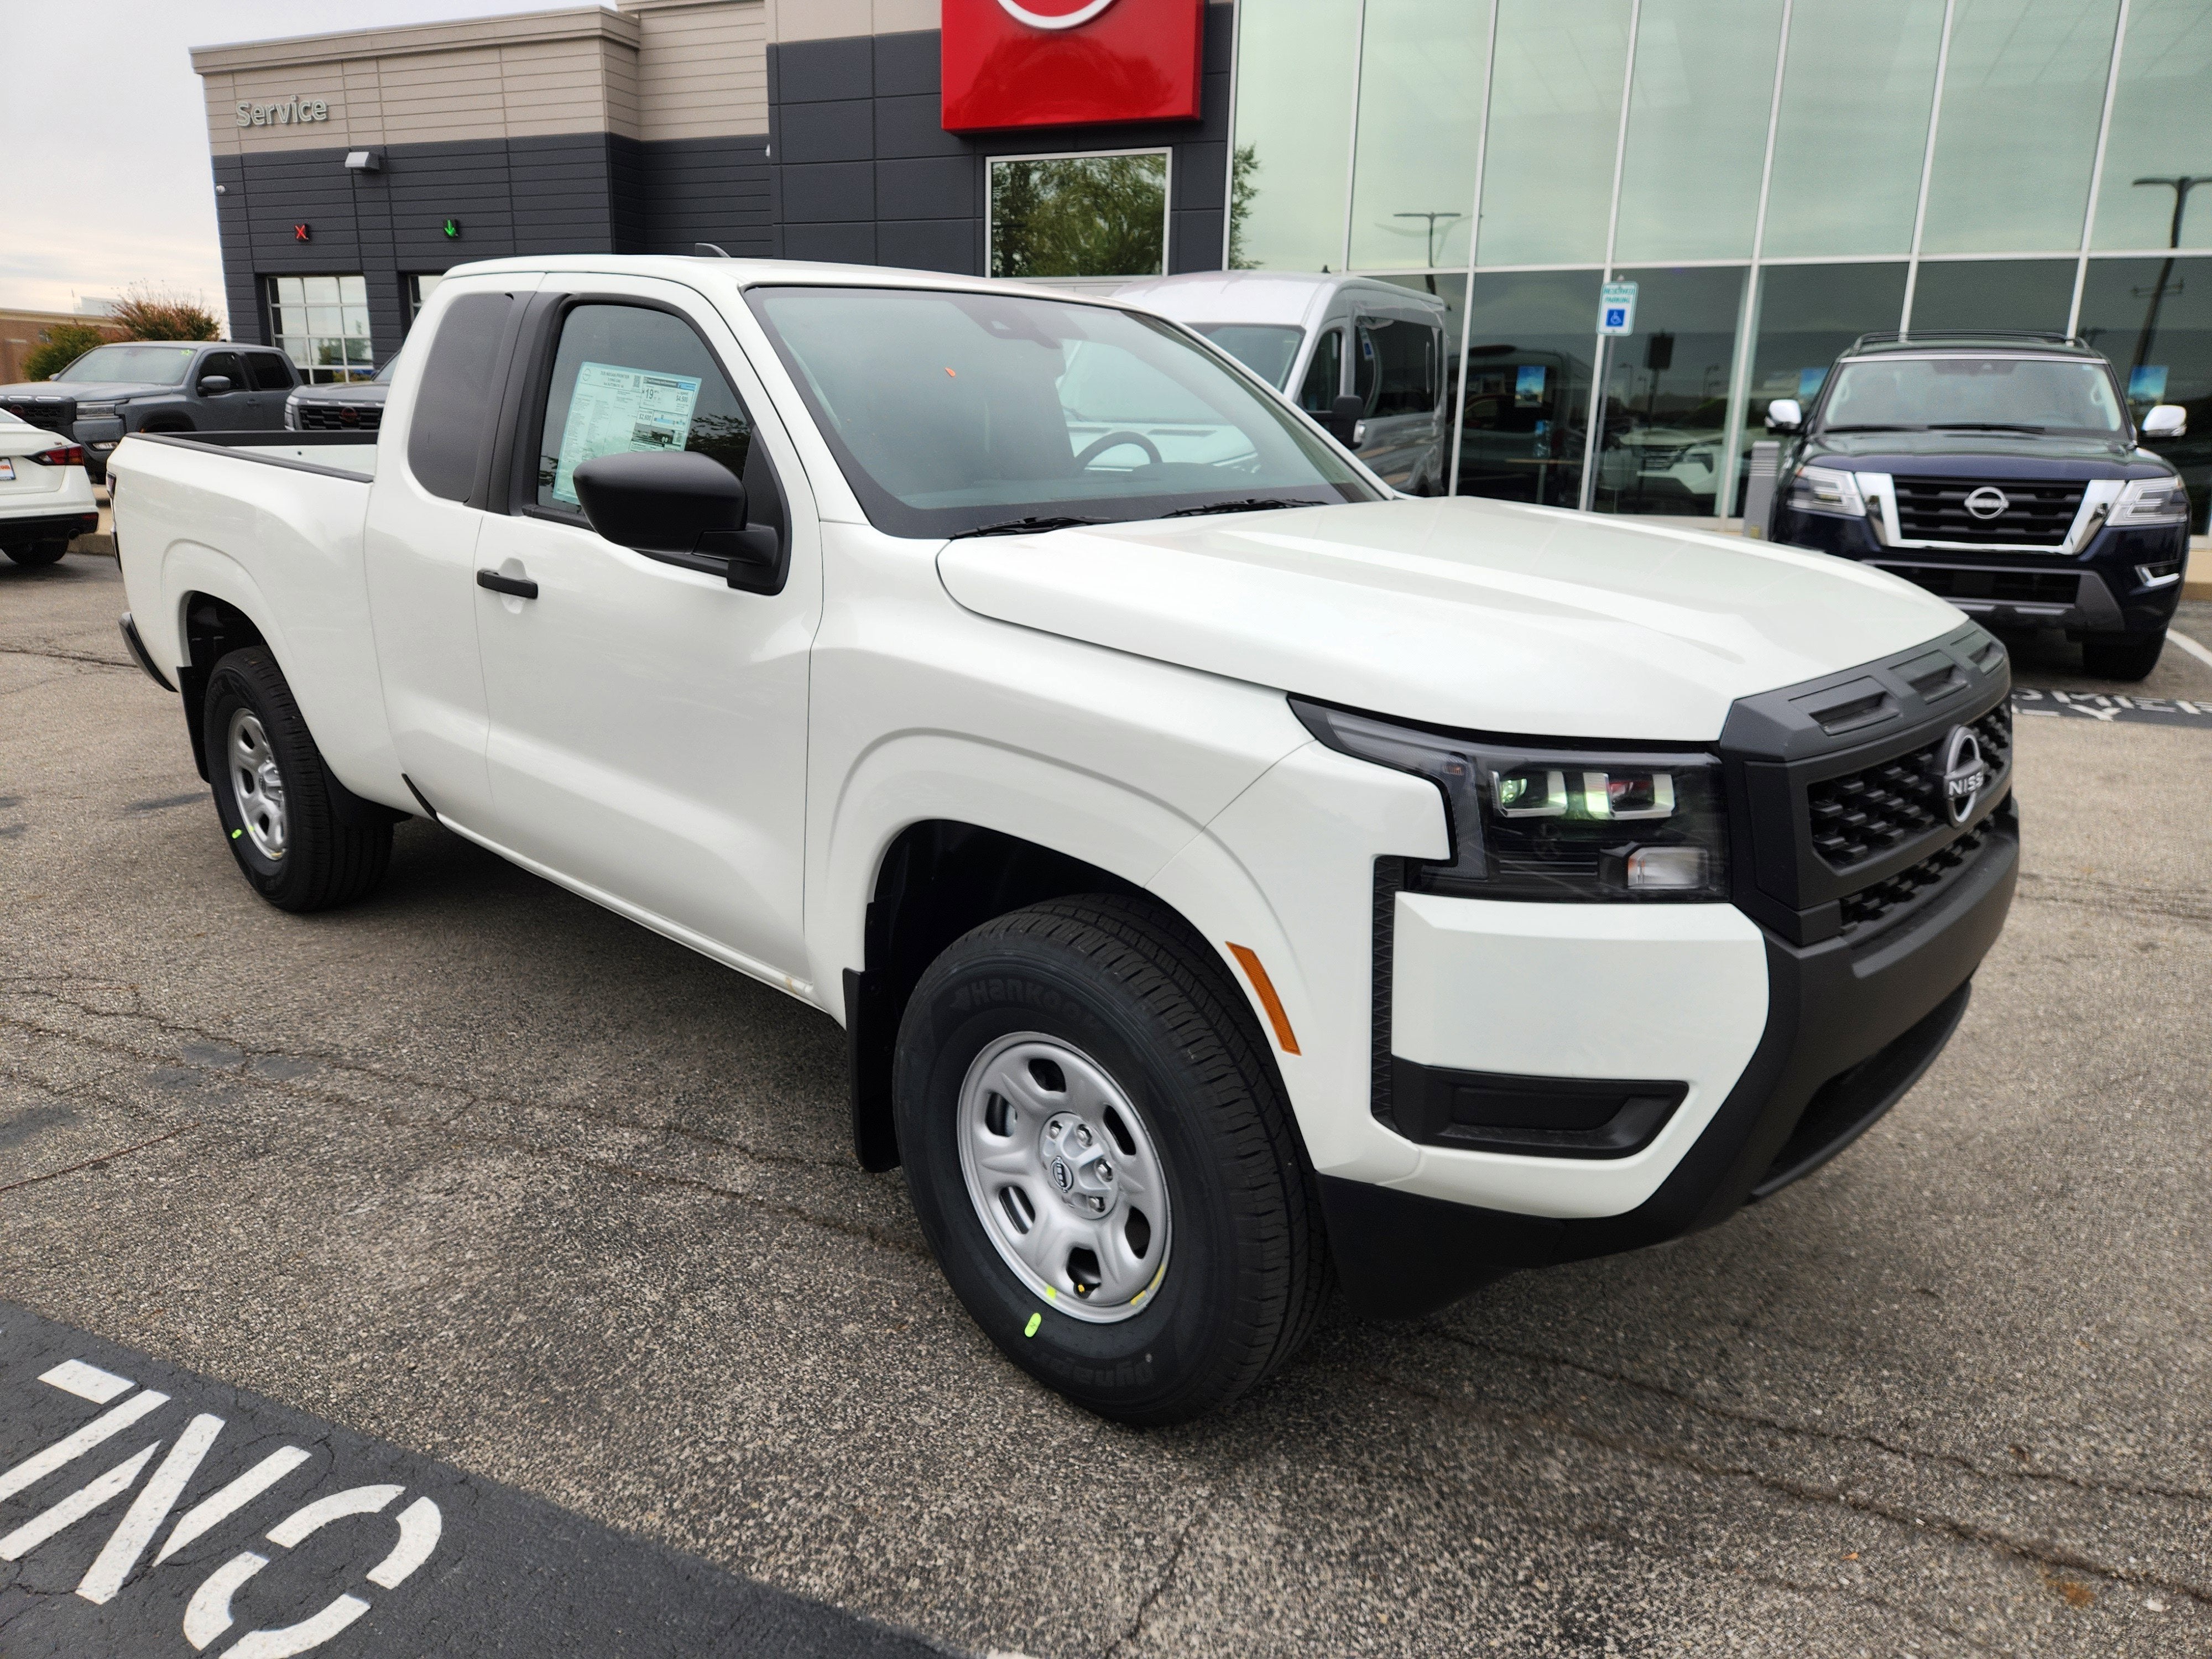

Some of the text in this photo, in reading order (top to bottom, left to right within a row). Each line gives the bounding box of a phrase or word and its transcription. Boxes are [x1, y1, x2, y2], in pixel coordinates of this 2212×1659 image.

[236, 95, 326, 127] Service
[646, 388, 654, 399] 19
[1948, 771, 1984, 796] NISS
[0, 1359, 442, 1659] ONL
